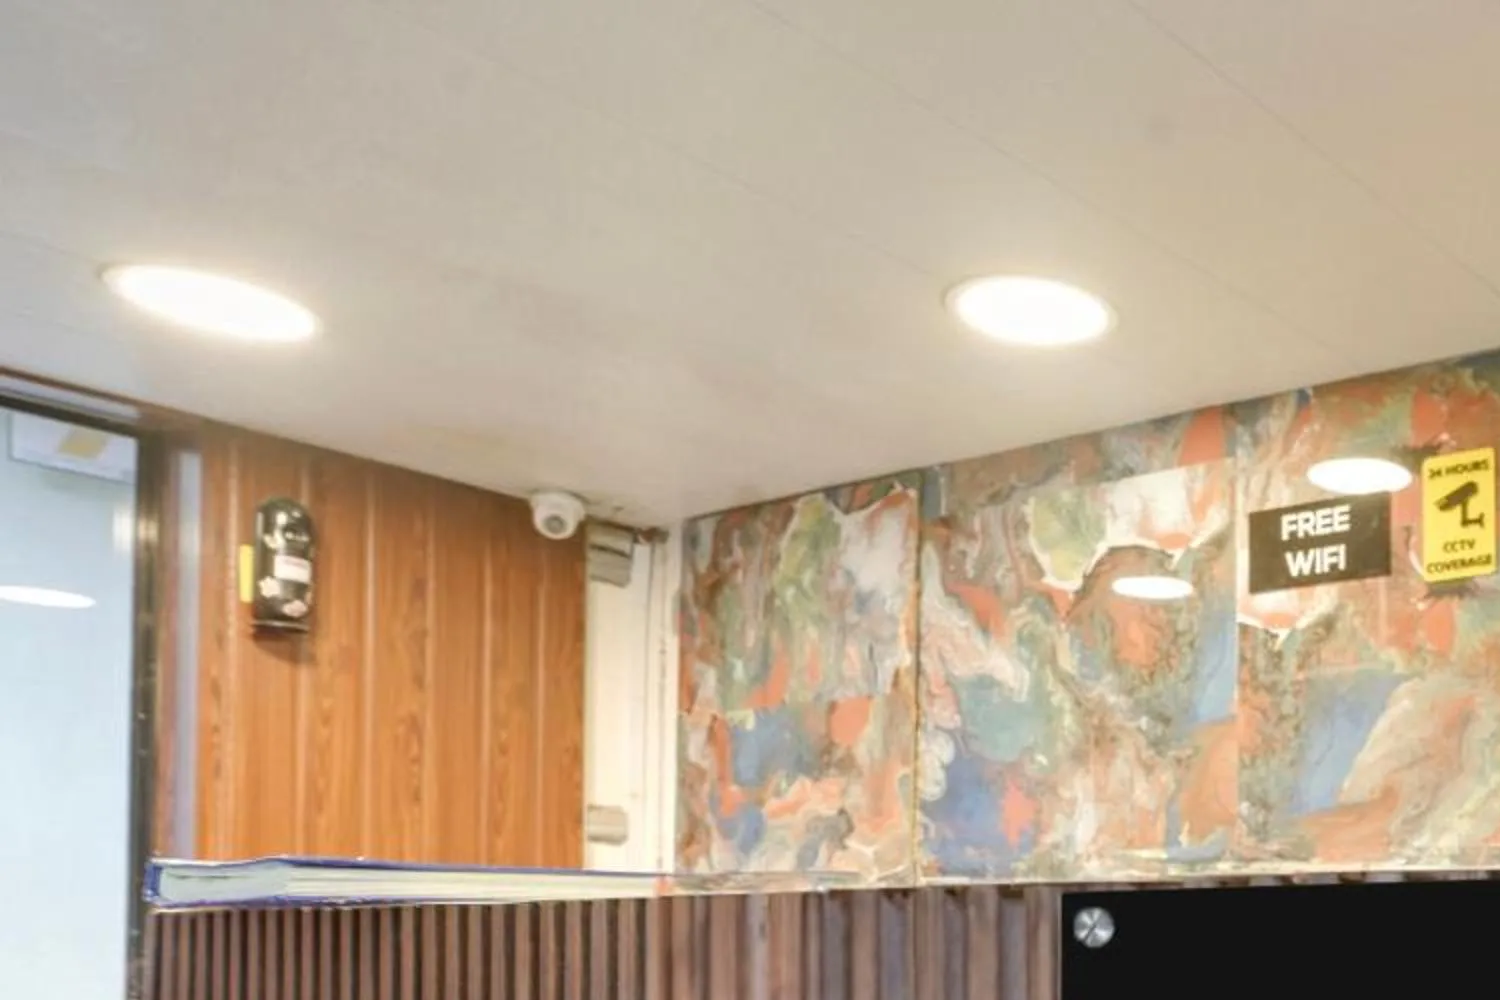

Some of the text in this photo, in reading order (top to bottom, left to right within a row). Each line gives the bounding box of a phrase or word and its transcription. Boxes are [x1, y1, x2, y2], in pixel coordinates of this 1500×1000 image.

[1445, 459, 1489, 475] HOURS
[1281, 504, 1351, 541] FREE
[1443, 539, 1475, 553] CCTV
[1284, 543, 1346, 577] WIFI
[1426, 554, 1492, 574] COVERAGE
